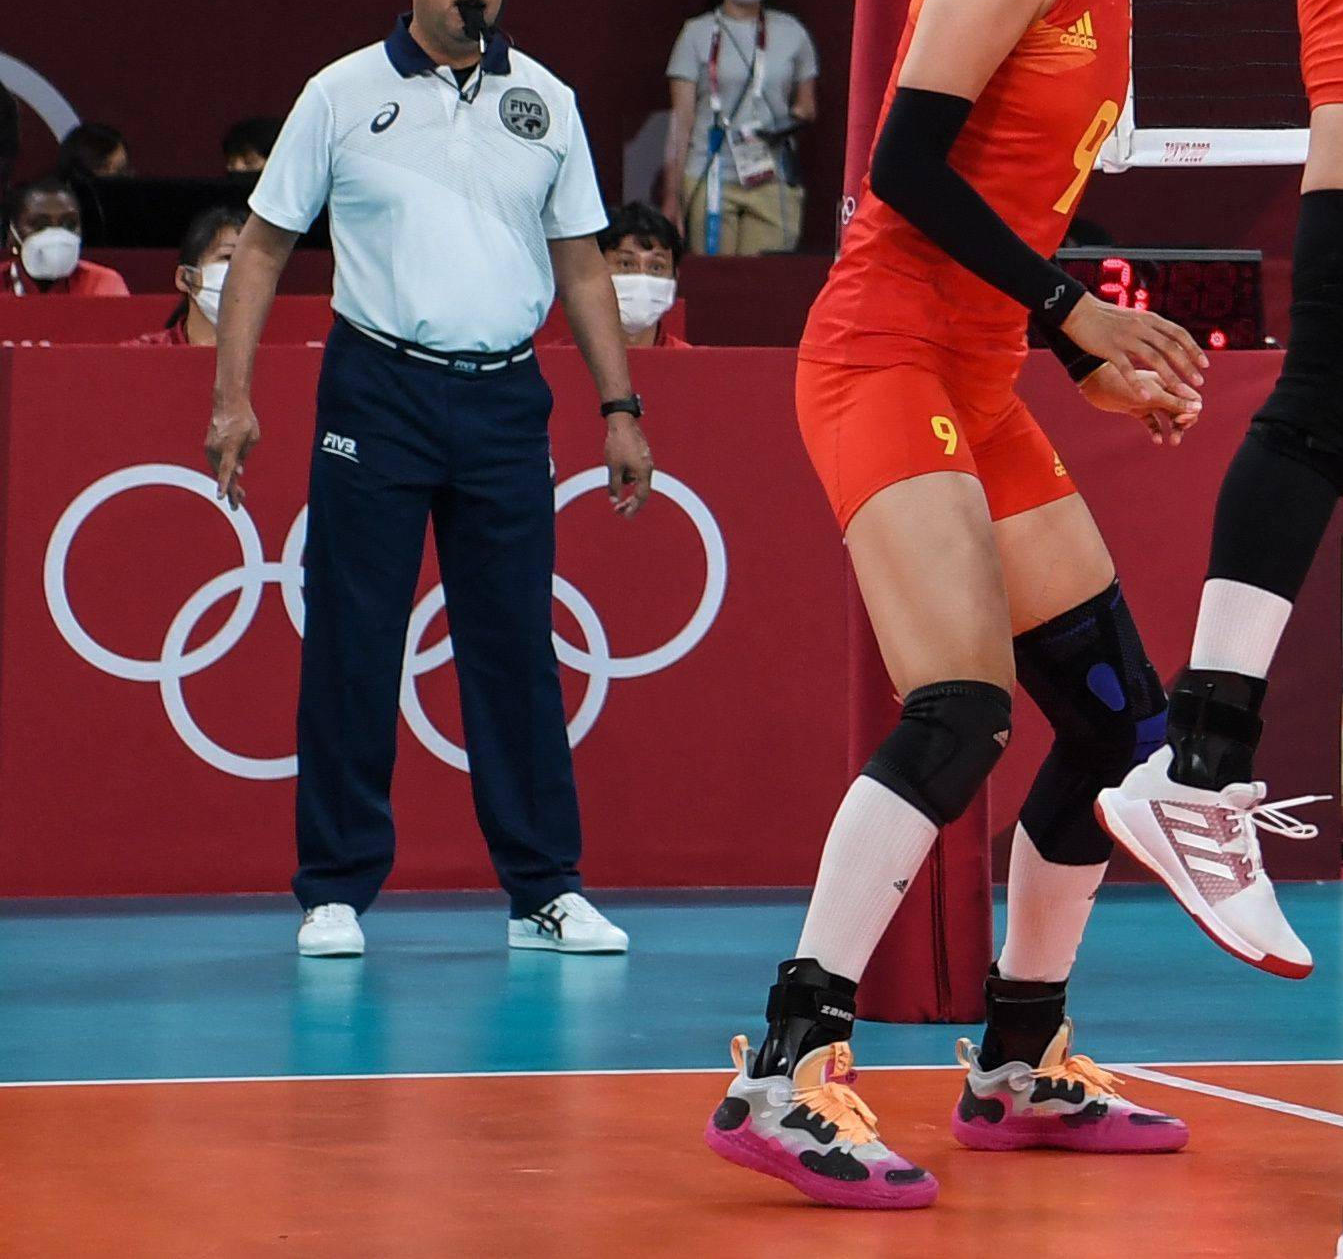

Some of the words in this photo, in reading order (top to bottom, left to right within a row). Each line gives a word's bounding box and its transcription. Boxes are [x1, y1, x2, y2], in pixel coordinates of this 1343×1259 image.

[1060, 31, 1098, 51] adidas
[510, 99, 543, 116] FIVB
[1052, 98, 1119, 216] 9
[322, 431, 358, 455] FIVB
[930, 414, 958, 456] 9
